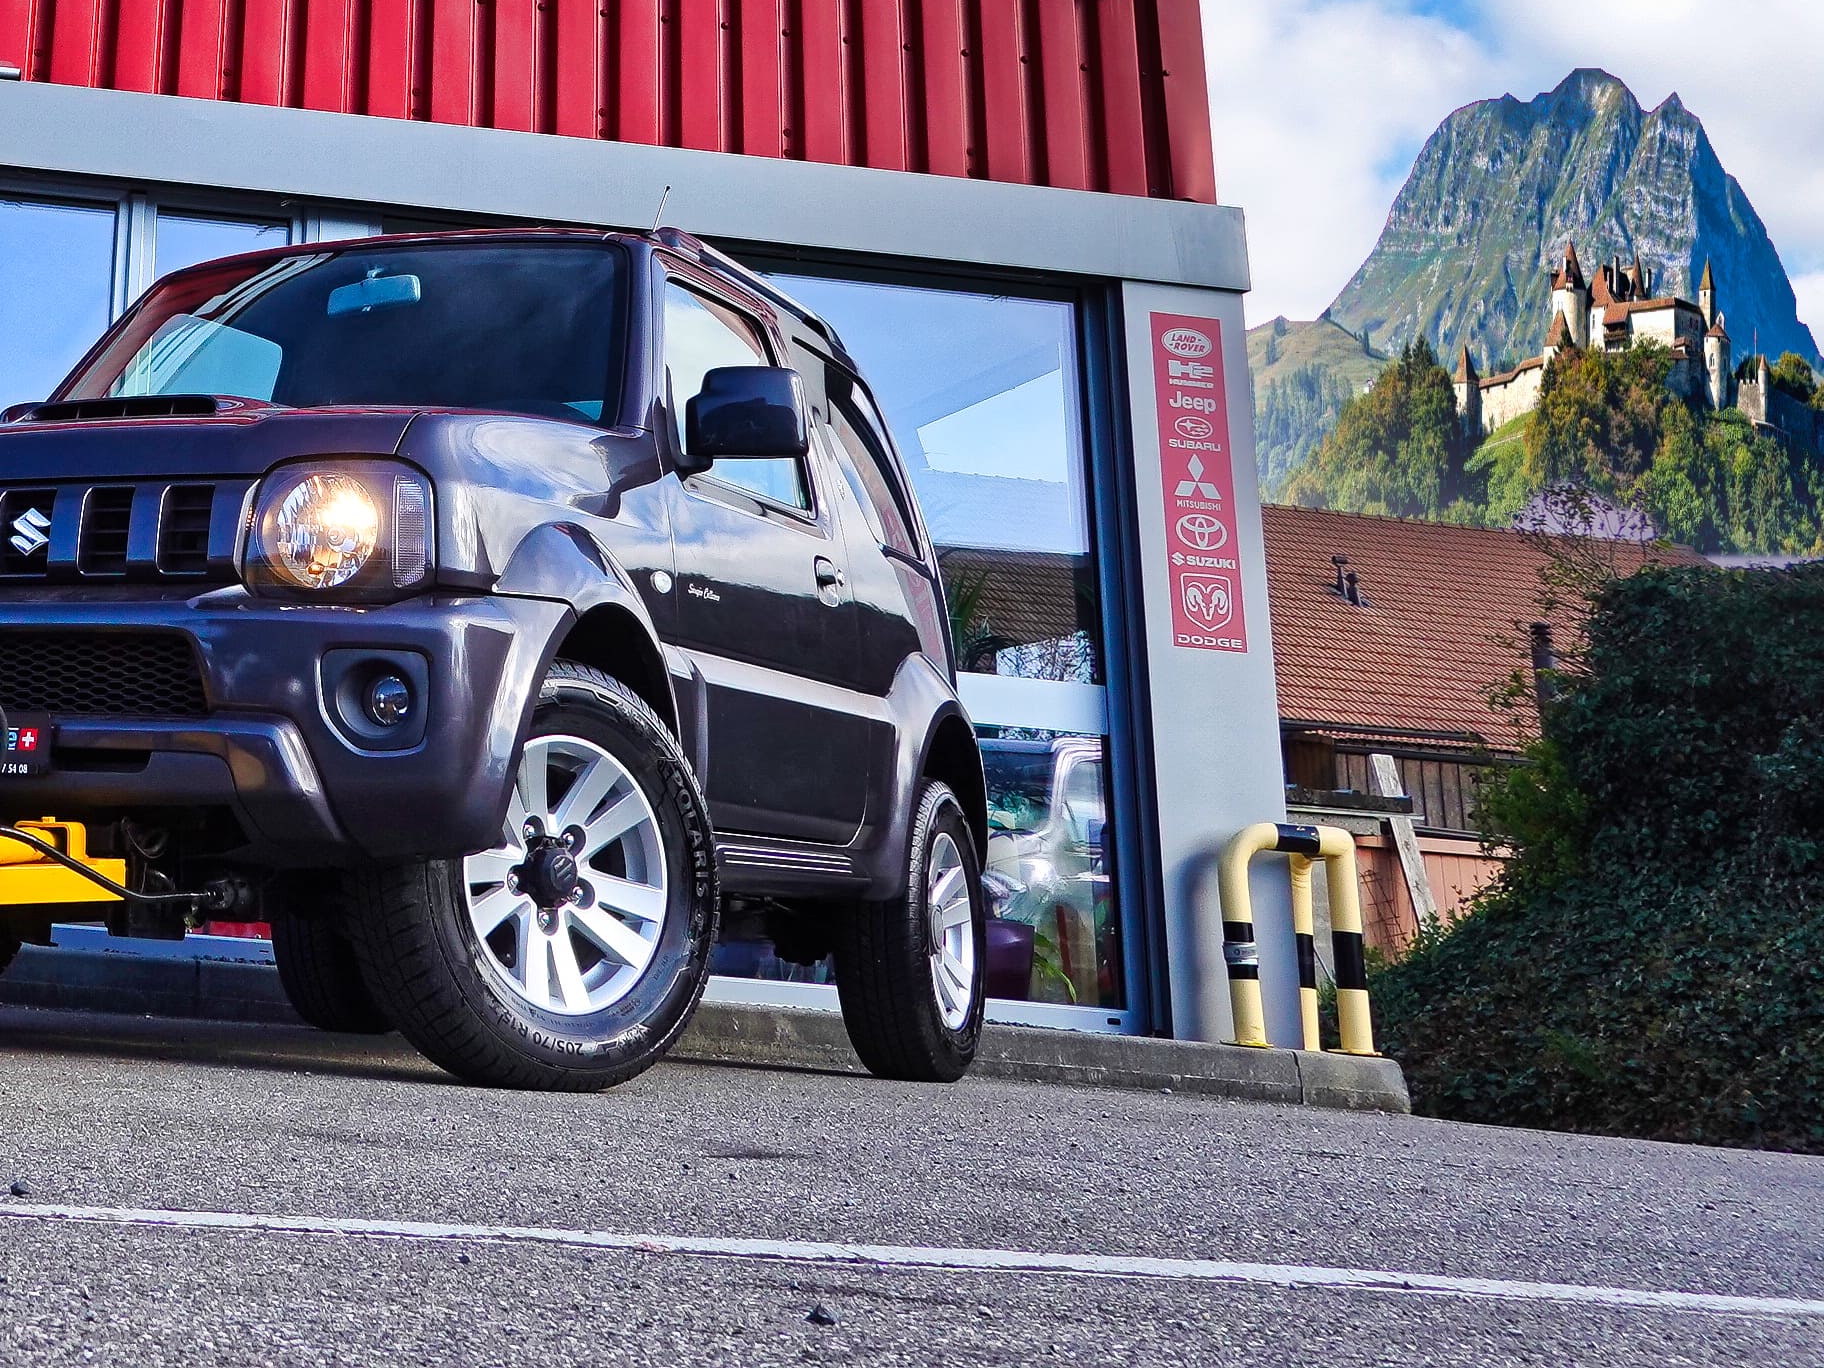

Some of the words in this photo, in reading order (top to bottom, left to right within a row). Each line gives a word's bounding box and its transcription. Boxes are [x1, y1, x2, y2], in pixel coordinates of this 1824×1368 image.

[1169, 391, 1217, 414] Jeep
[1168, 438, 1222, 452] SUBARU
[1176, 499, 1222, 511] MITSUBISHI
[1186, 554, 1236, 569] SUZUKI
[1177, 634, 1243, 649] DODGE
